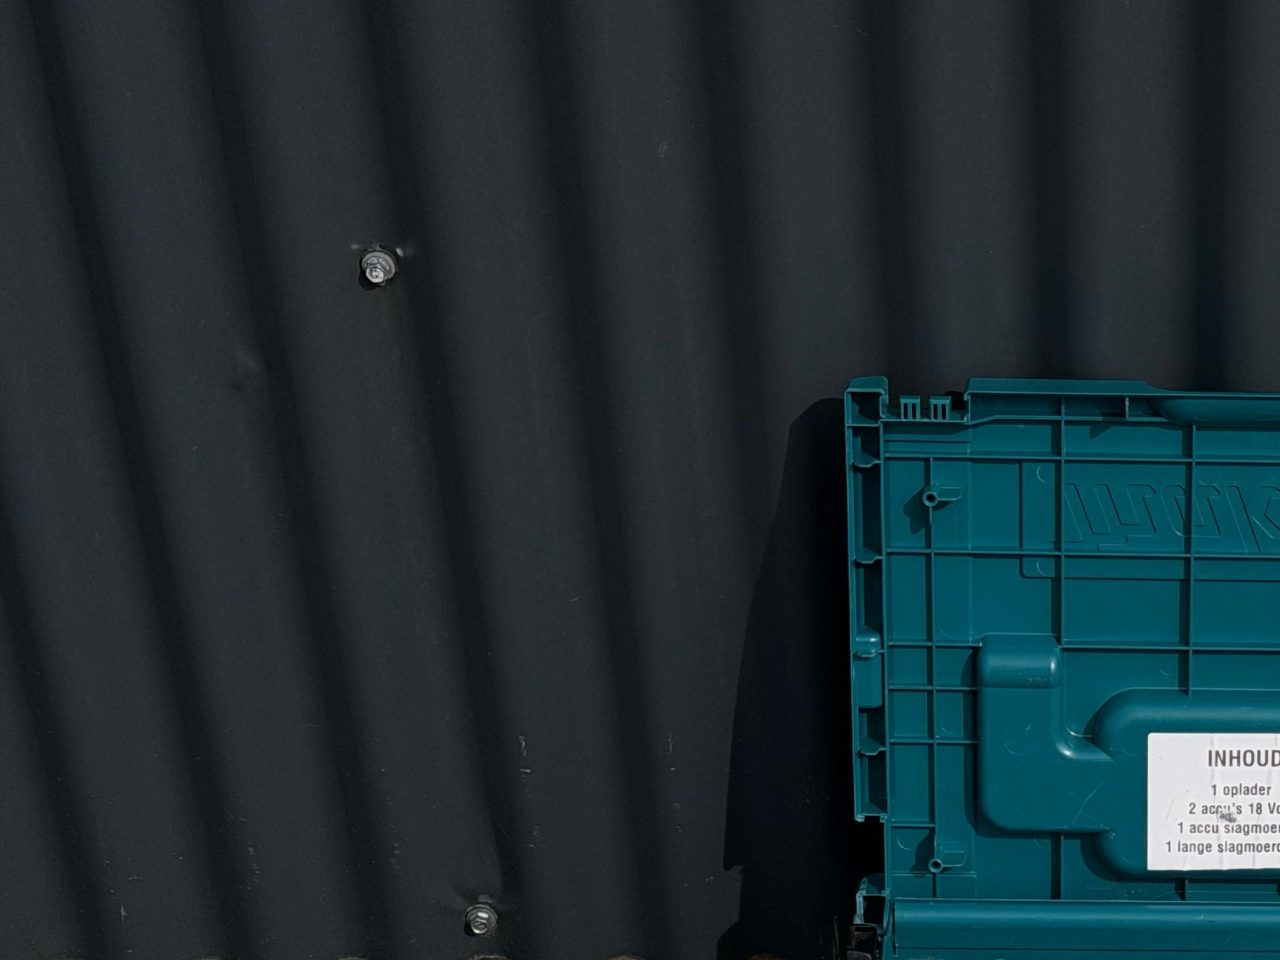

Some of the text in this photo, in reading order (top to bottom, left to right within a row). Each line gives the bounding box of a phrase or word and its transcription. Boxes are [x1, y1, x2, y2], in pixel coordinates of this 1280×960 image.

[1211, 783, 1272, 798] 1 oplader
[1188, 802, 1196, 815] 2
[1248, 802, 1263, 815] 18
[1178, 822, 1184, 834] 1
[1189, 824, 1219, 834] accu
[1165, 841, 1172, 853] 1
[1177, 840, 1212, 855] lange
